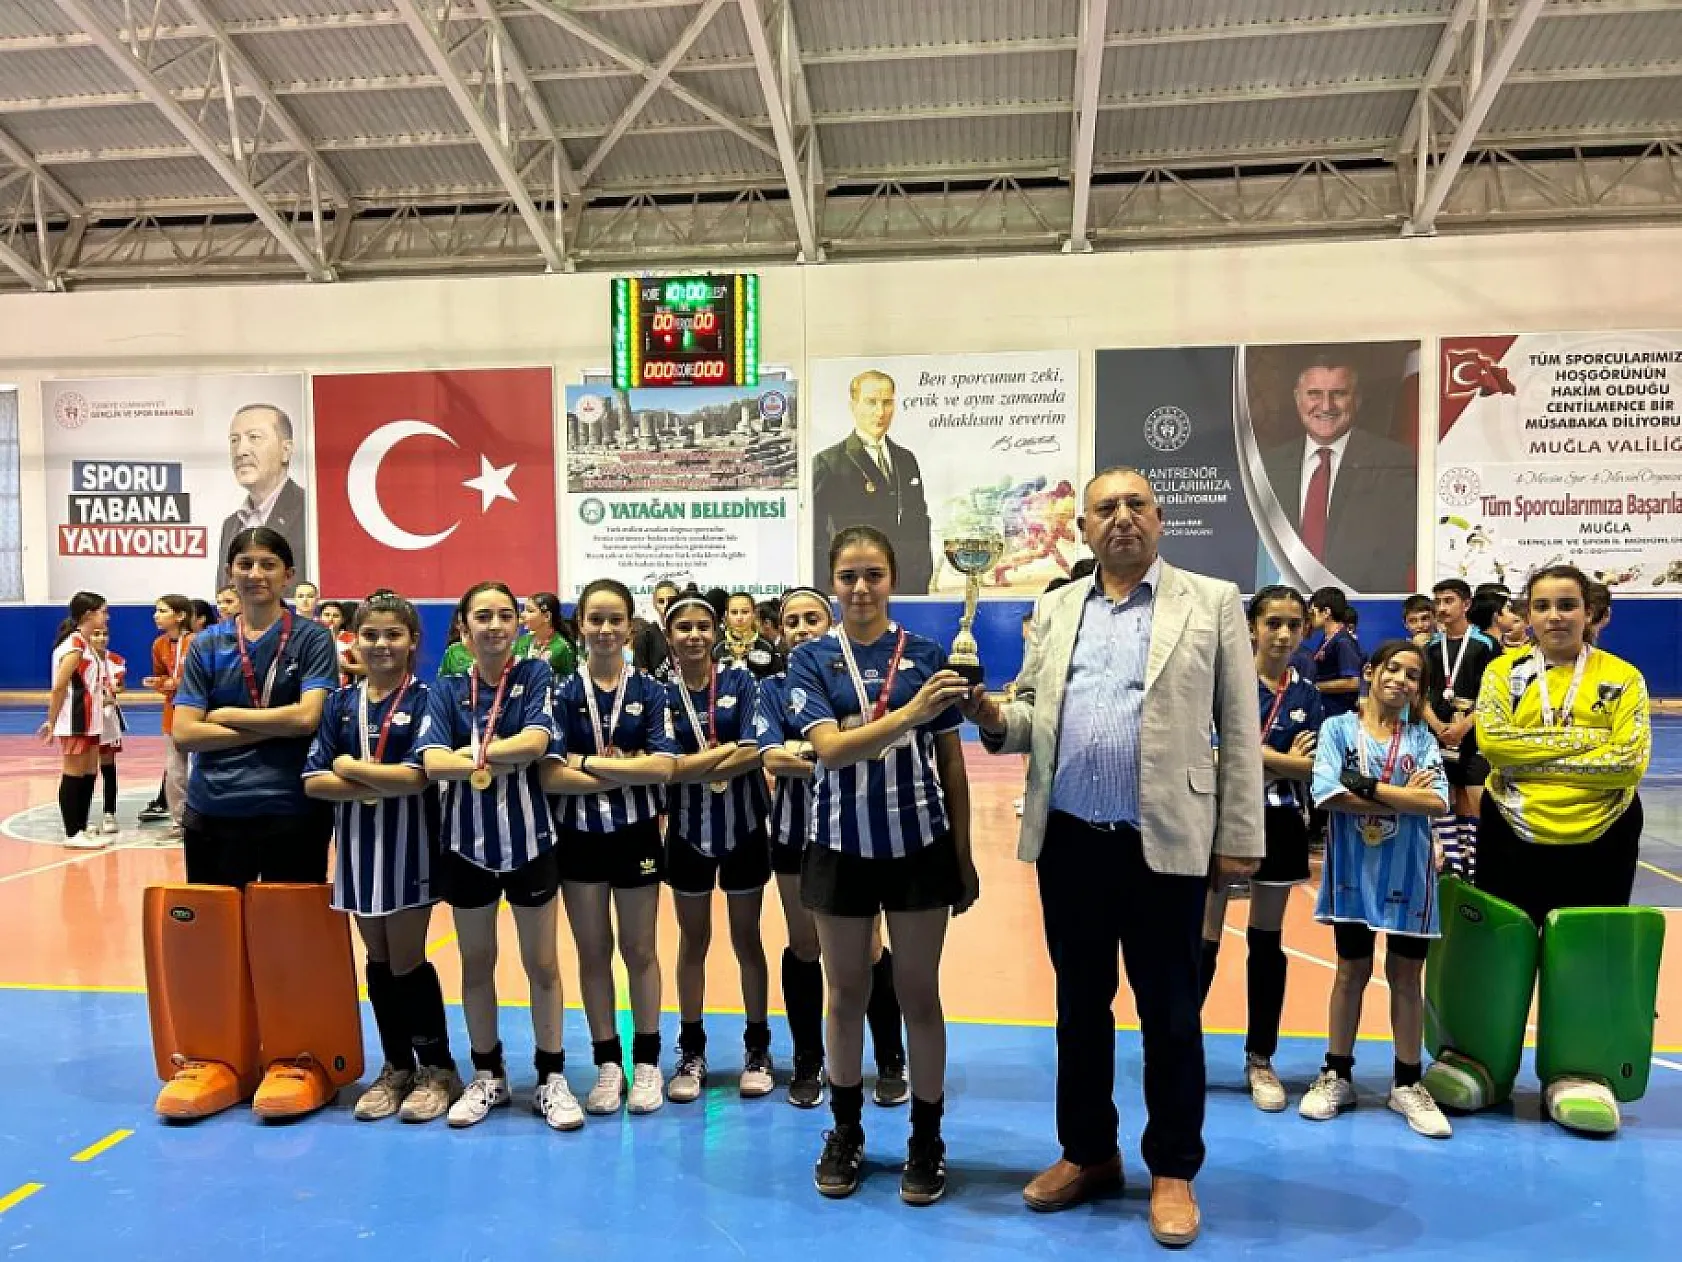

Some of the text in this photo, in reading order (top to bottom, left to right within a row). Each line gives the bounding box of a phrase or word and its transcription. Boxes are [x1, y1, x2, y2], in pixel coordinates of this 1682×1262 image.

[654, 313, 673, 330] 00
[694, 311, 713, 330] 00
[1529, 351, 1560, 366] TÜM
[644, 361, 674, 378] 000
[695, 360, 724, 377] 000
[918, 367, 1064, 388] Ben sporcunun zeki,
[1555, 365, 1666, 383] HOŞGÖRÜNÜN
[1551, 382, 1670, 397] HAKİM OLDUĞU
[903, 388, 1066, 410] çevik ve aynı zamanda
[1546, 396, 1674, 413] CENTİLMENCE BİR
[928, 410, 1066, 428] ahlaklısını severim
[1525, 415, 1607, 430] MÜSABAKA
[1529, 438, 1601, 453] MUĞLA
[82, 463, 168, 491] SPORU
[1148, 466, 1217, 479] ANTRENÖR
[75, 495, 181, 523] TABANA
[609, 497, 787, 520] YATAĞAN BELEDİYESİ
[1480, 495, 1512, 517] Tüm
[1514, 493, 1623, 522] Sporcularımıza
[1579, 521, 1632, 535] MUĞLA
[61, 527, 205, 555] YAYIYORUZ
